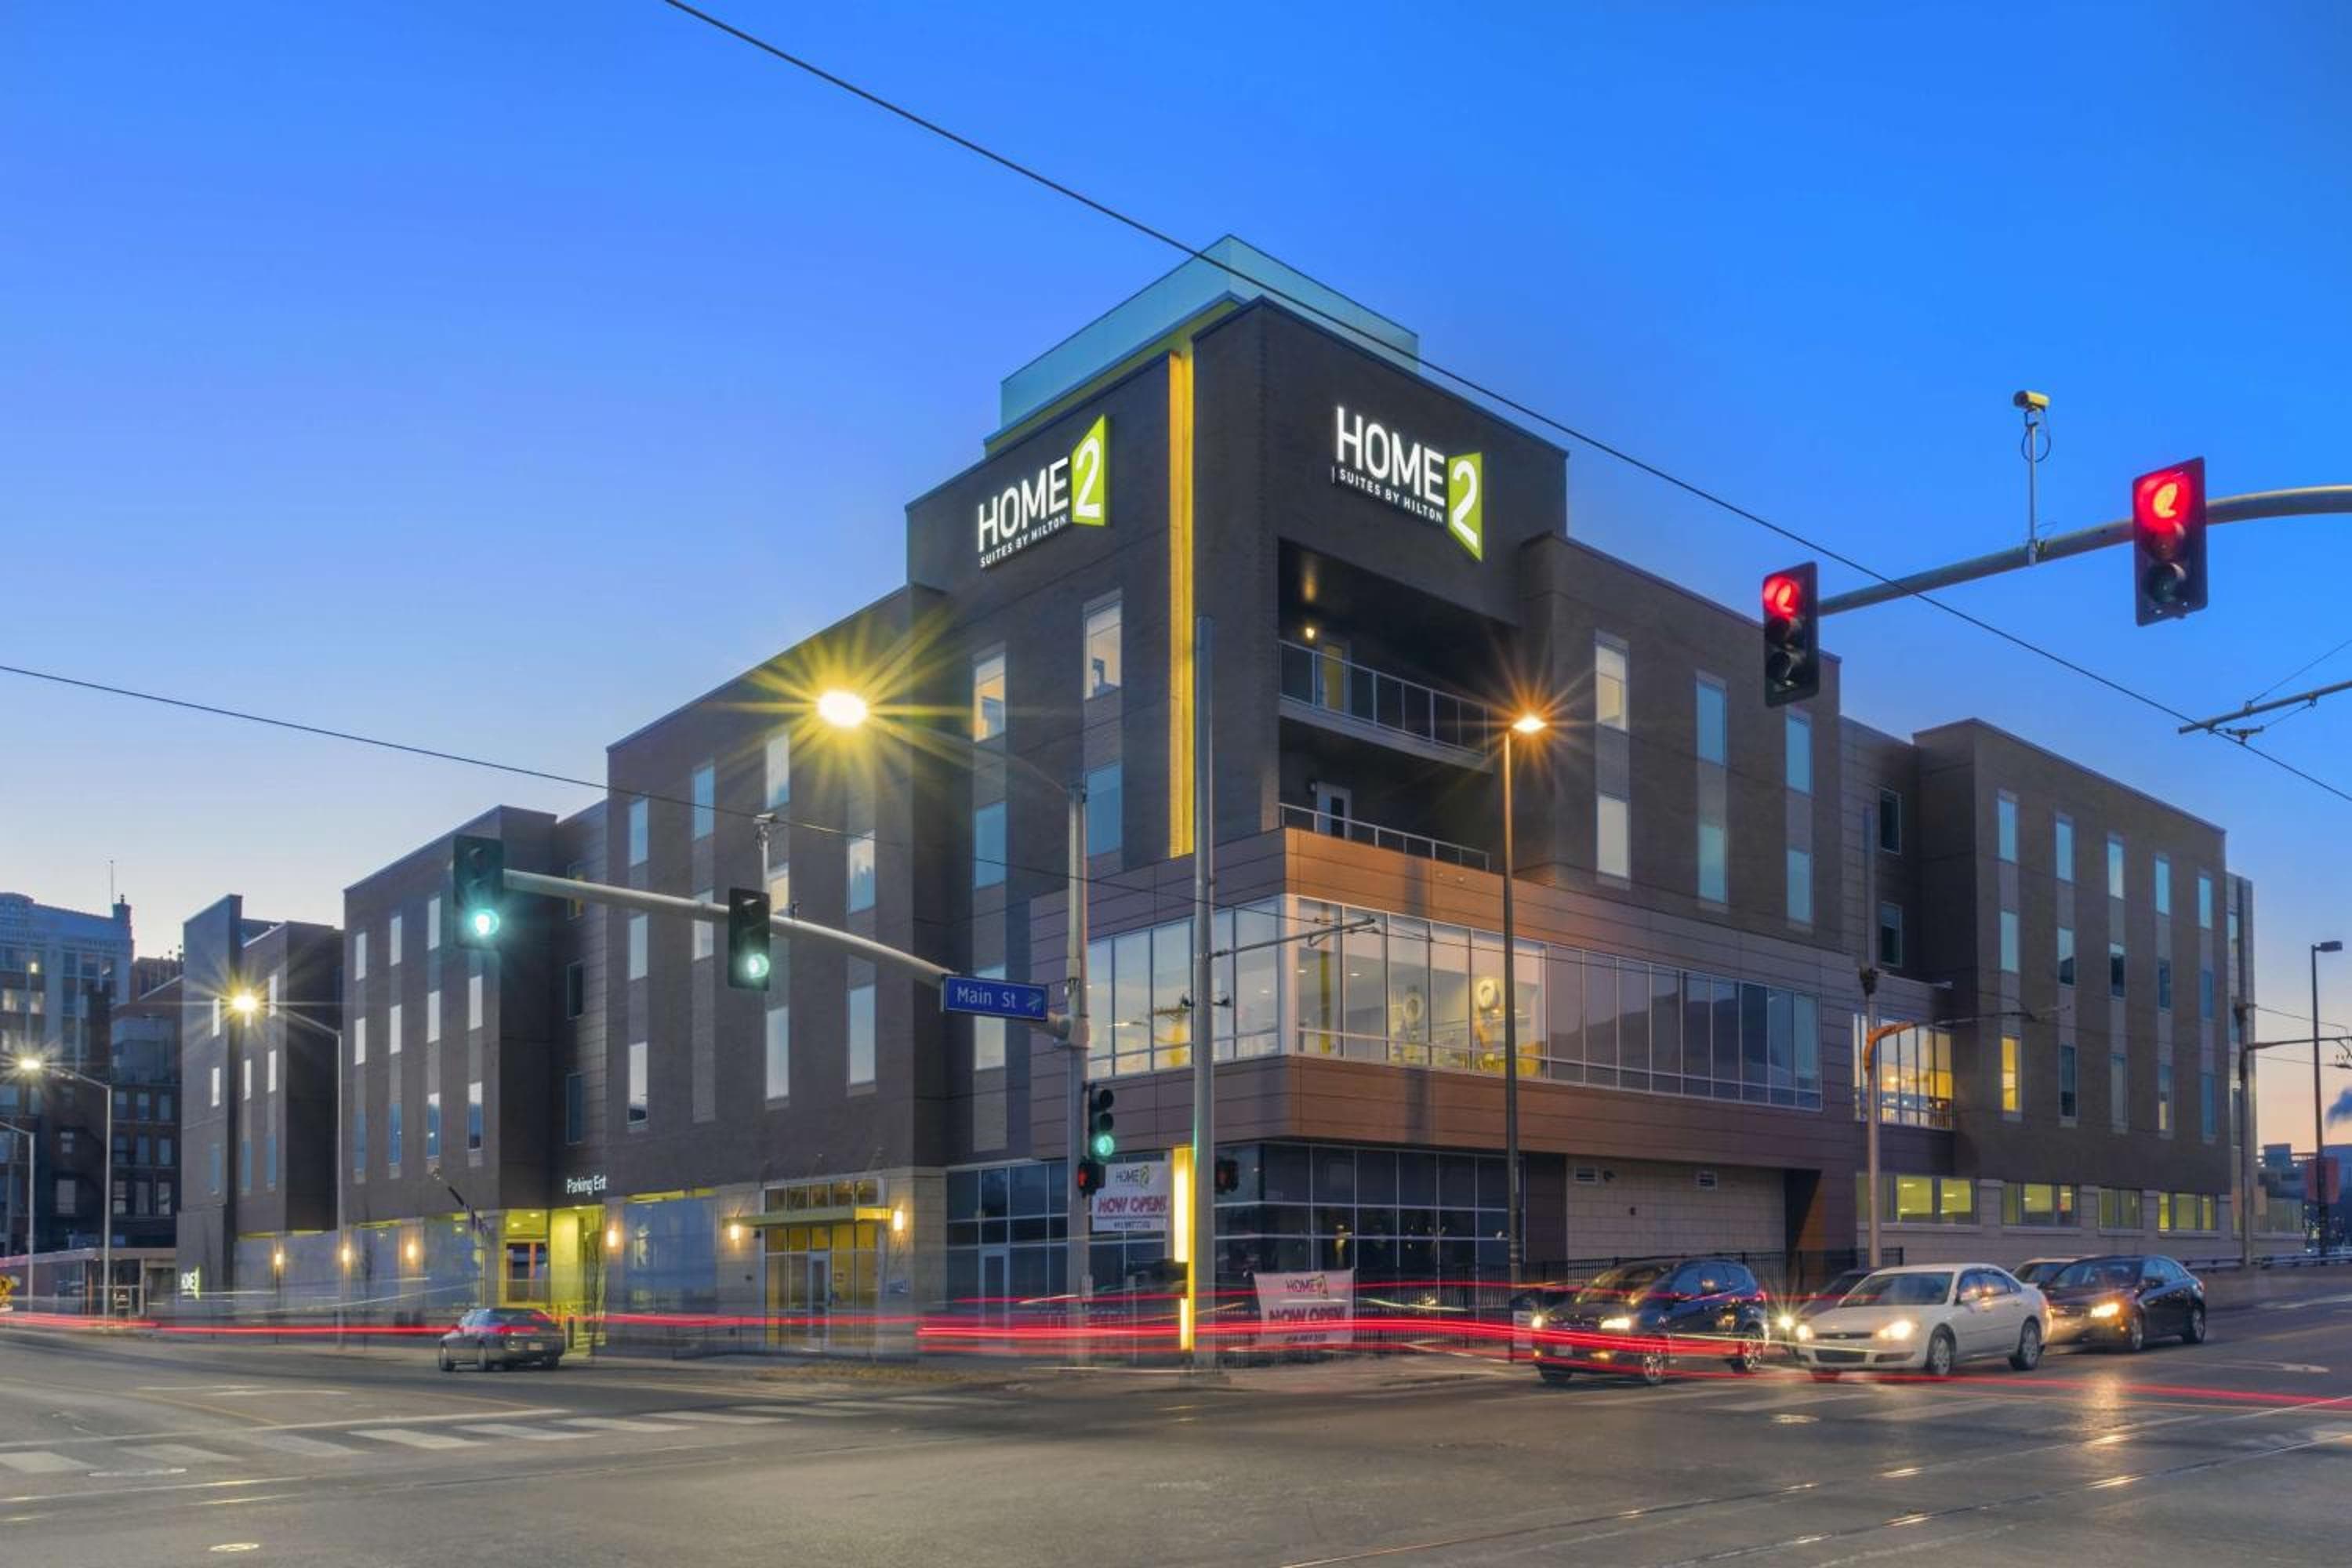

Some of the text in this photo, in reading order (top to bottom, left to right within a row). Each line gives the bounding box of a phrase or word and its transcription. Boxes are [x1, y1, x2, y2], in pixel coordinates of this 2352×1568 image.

[1338, 405, 1478, 549] HOME 2
[978, 437, 1101, 553] HOME 2
[1340, 469, 1443, 523] SUITES BY HILTON
[980, 514, 1067, 568] SUITES BY HILTON
[956, 986, 1016, 1009] Main St
[1116, 1169, 1139, 1182] HOME
[567, 1177, 593, 1196] Parking
[1098, 1196, 1128, 1213] NOW
[1286, 1279, 1317, 1292] HOME
[1269, 1307, 1306, 1323] NOW
